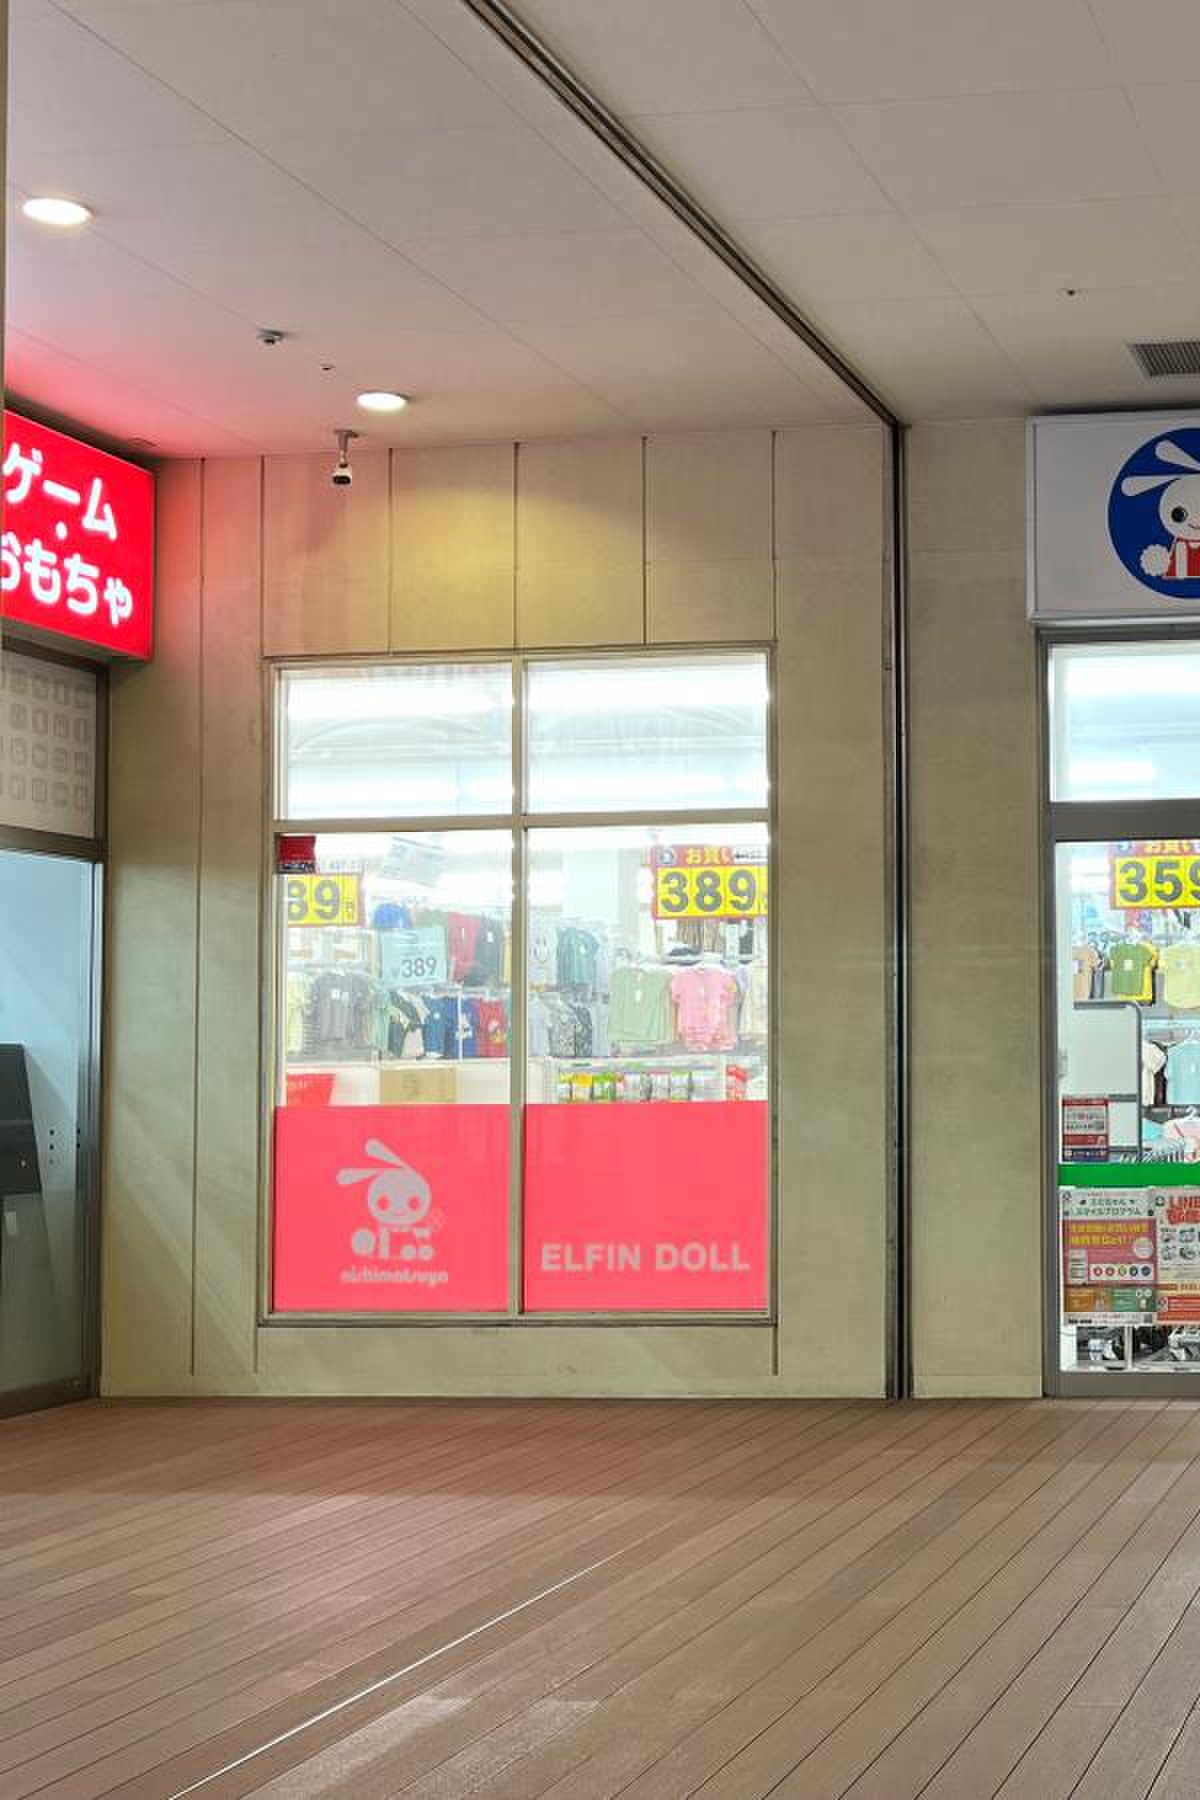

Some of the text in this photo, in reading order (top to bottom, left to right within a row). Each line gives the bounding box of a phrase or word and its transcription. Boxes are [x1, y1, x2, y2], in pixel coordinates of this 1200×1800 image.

[2, 441, 118, 542] ゲーム
[660, 868, 756, 913] 389
[540, 1241, 752, 1272] ELFIN DOLL
